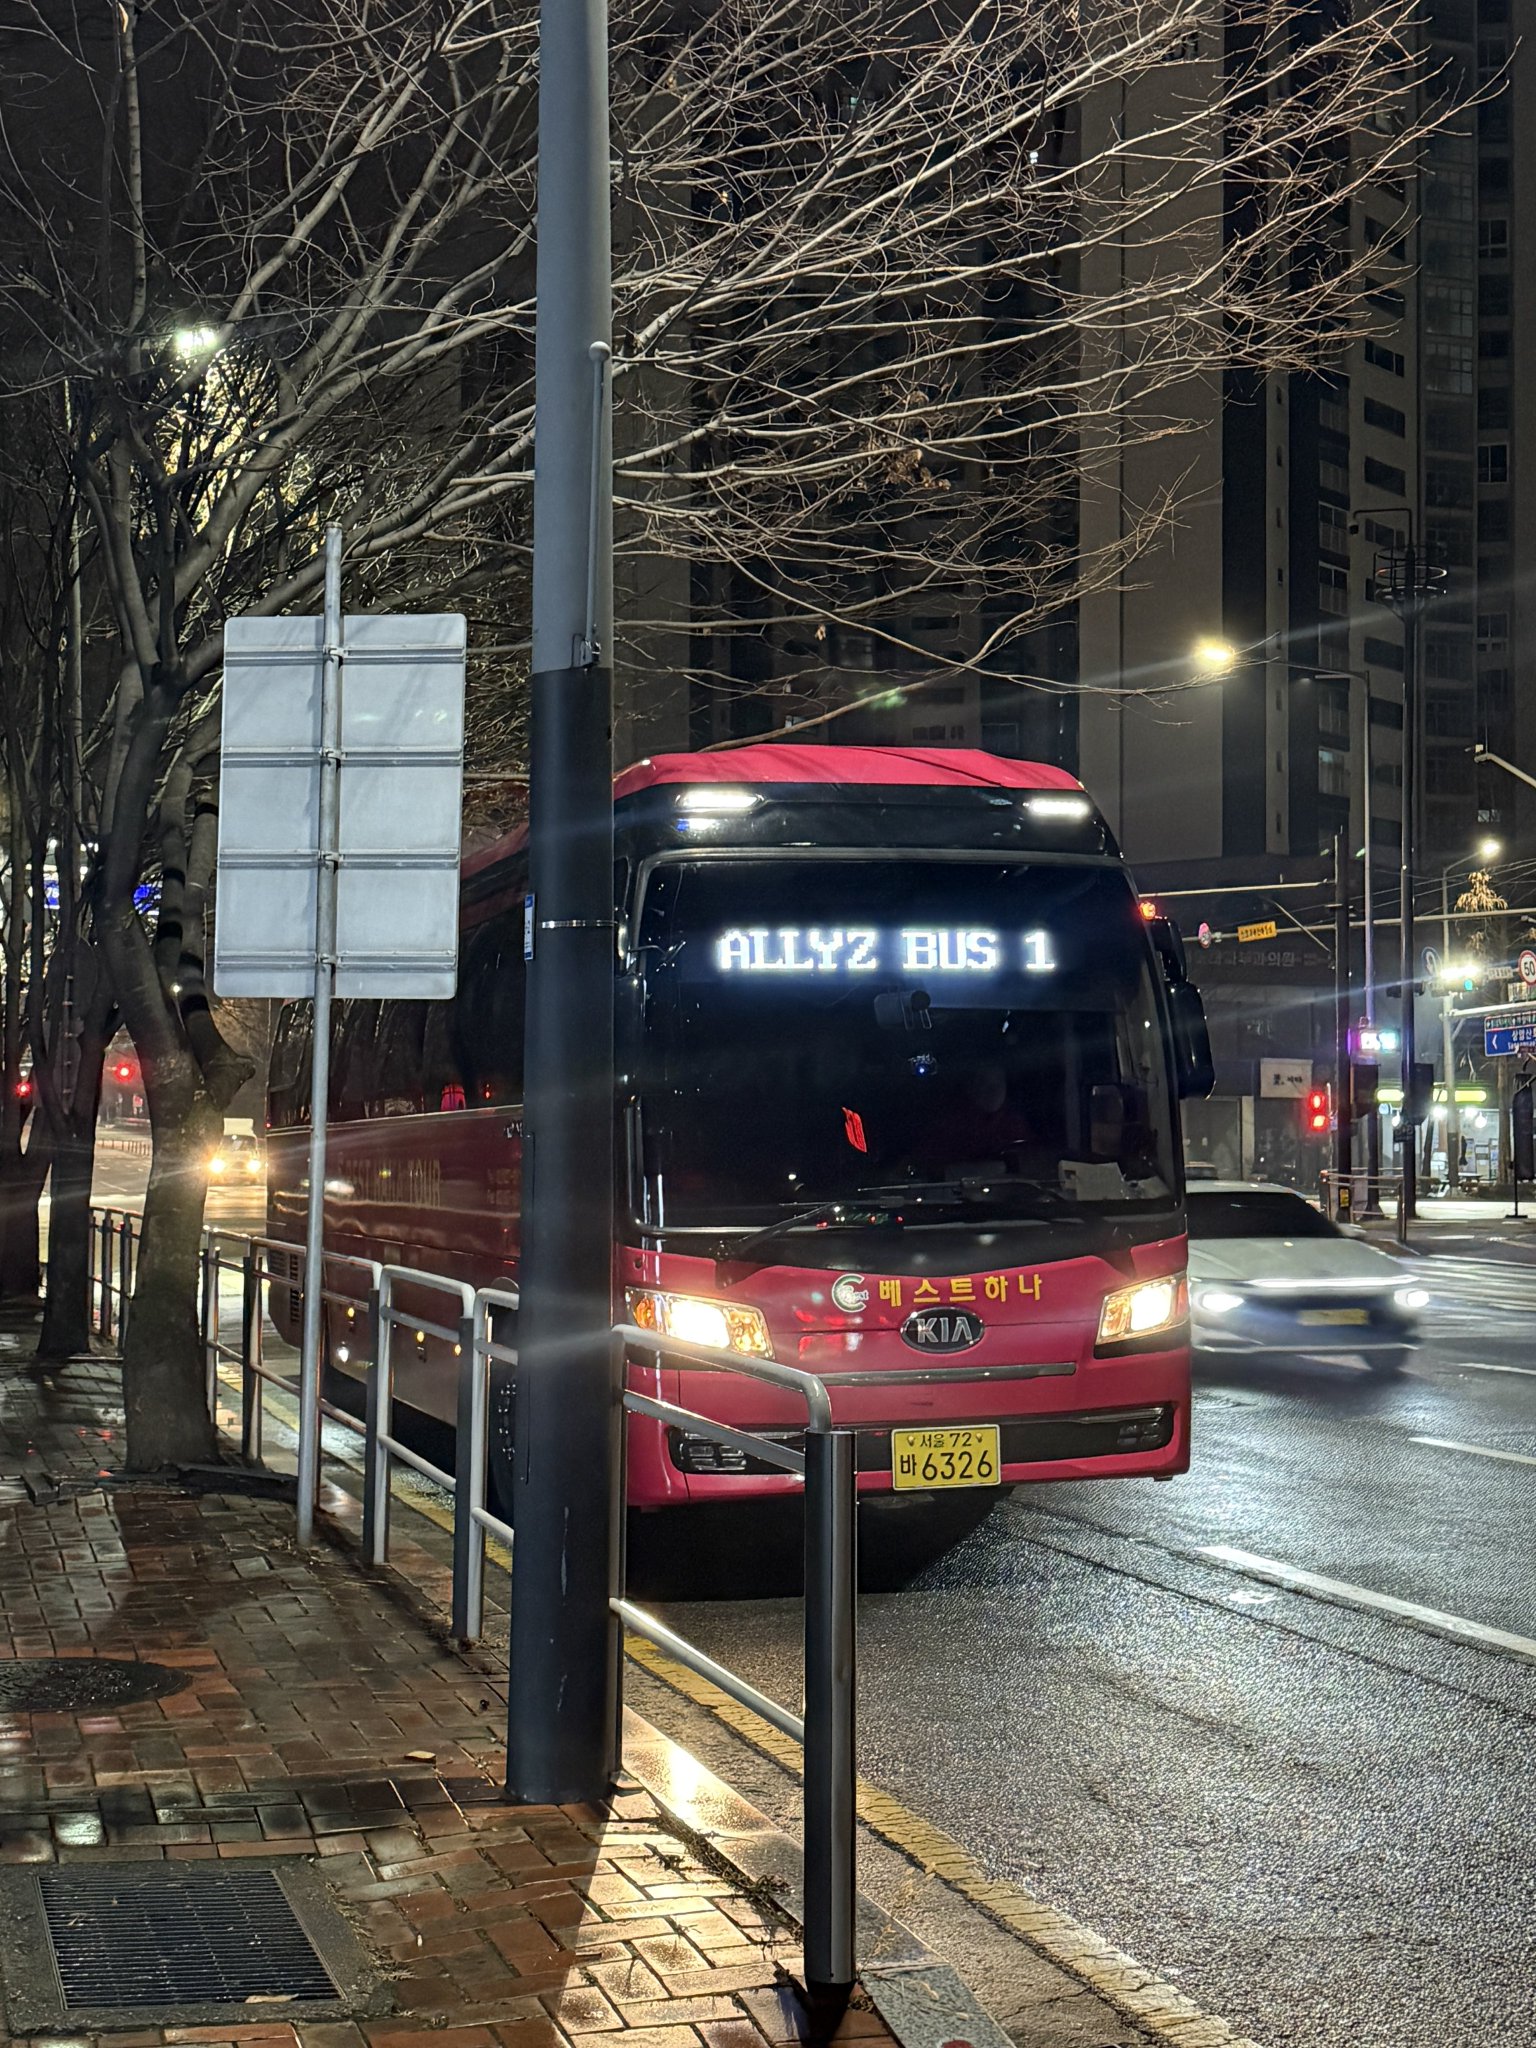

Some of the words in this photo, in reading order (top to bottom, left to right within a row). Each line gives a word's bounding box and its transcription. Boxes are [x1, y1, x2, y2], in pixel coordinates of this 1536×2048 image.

[718, 930, 877, 970] ALLYZ
[902, 931, 997, 970] BUS
[1025, 931, 1055, 970] 1
[1523, 961, 1536, 977] 50
[879, 1273, 1042, 1307] 베스트하나
[916, 1316, 974, 1344] KIA
[919, 1433, 946, 1449] 서울
[949, 1431, 973, 1448] 72
